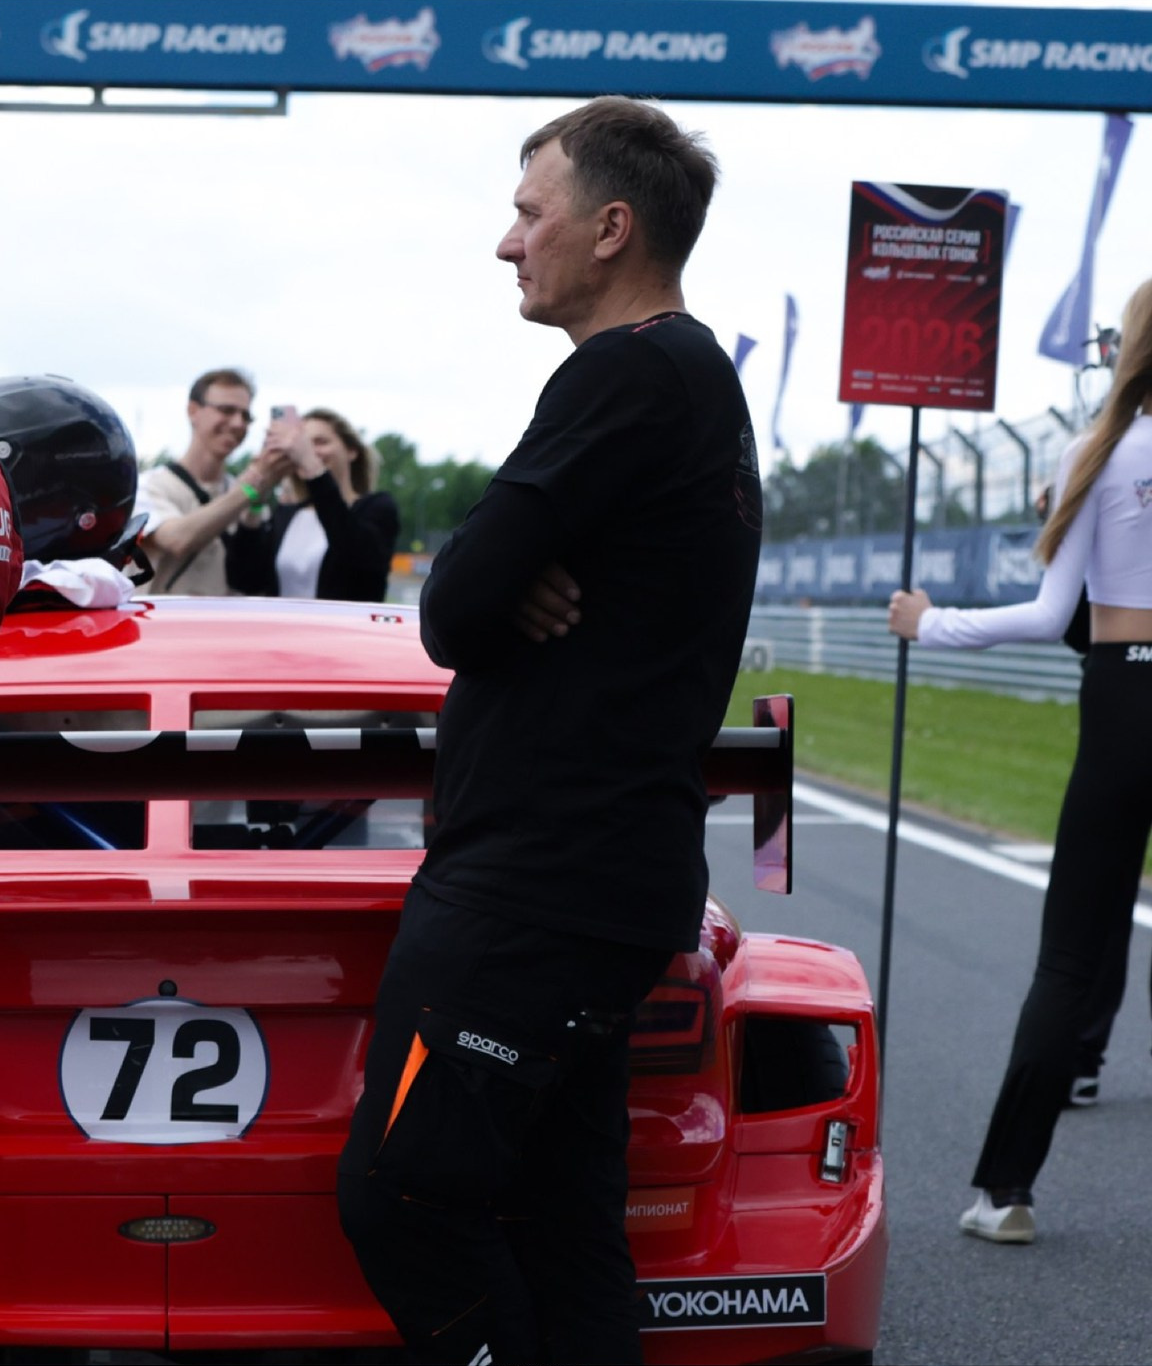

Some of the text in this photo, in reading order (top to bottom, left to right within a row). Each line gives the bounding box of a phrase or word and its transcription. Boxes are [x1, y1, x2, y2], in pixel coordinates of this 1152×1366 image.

[87, 21, 286, 55] SMP RACING
[528, 29, 727, 62] SMP RACING
[968, 38, 1041, 69] SMP
[945, 230, 981, 246] СЕРИЯ
[942, 246, 979, 263] ГОНОК
[458, 1031, 519, 1063] sparco
[89, 1017, 241, 1123] 72
[625, 1202, 690, 1217] МПИОНАТ
[648, 1287, 809, 1317] YOKOHAMA
